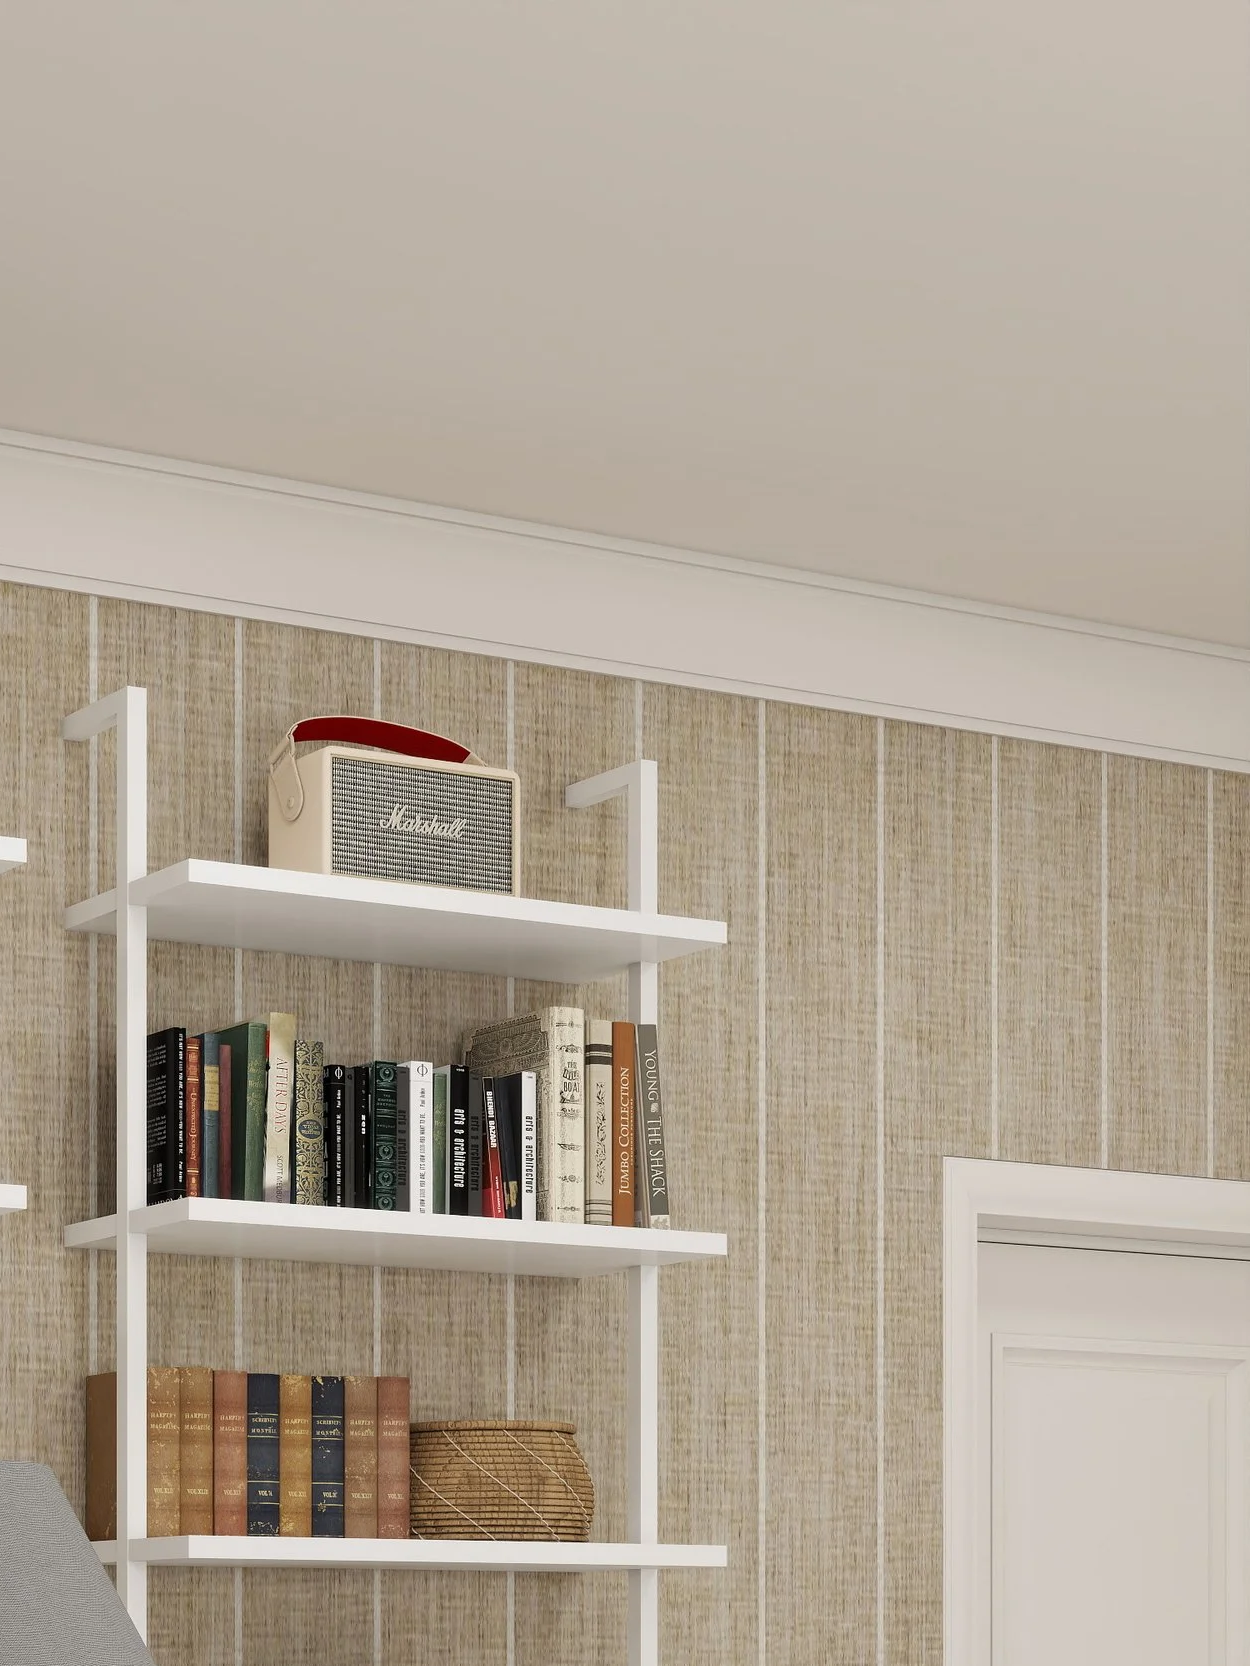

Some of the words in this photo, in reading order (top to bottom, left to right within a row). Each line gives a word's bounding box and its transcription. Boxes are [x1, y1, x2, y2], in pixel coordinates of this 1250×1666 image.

[380, 804, 466, 839] Marshall
[275, 1057, 289, 1098] AFTER
[644, 1049, 659, 1101] YOUNG
[274, 1101, 288, 1133] DAYS
[454, 1108, 466, 1125] arts
[526, 1116, 534, 1131] arts
[618, 1067, 630, 1147] COLLECTION
[489, 1120, 497, 1148] BAZAAR
[649, 1116, 662, 1145] THE
[454, 1138, 466, 1188] architecture
[526, 1145, 534, 1194] architecture
[619, 1152, 632, 1195] JUMBO
[650, 1150, 666, 1197] SHACK
